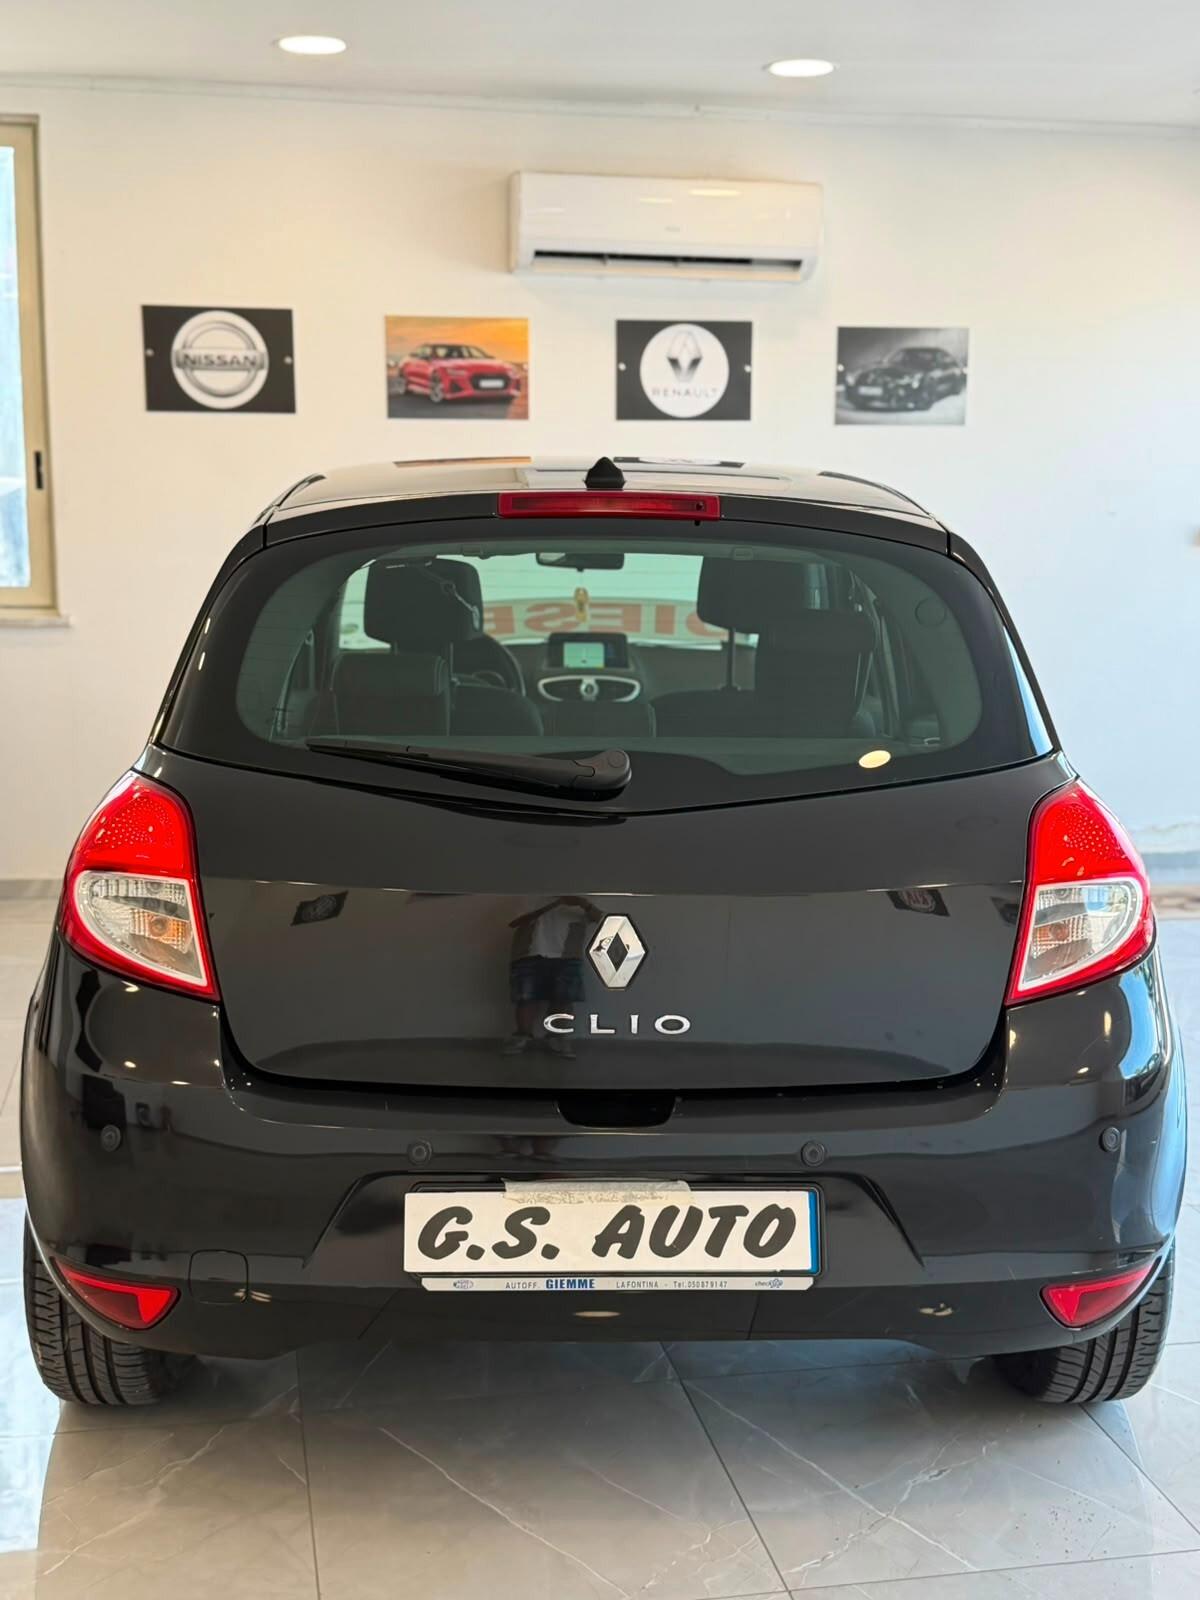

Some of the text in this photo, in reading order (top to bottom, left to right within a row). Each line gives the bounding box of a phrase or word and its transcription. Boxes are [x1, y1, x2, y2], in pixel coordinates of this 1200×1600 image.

[182, 352, 258, 367] NISSAN
[651, 387, 718, 399] RENAULT
[543, 1013, 691, 1035] CLIO
[417, 1203, 797, 1261] G.S. AUTO
[545, 1278, 596, 1289] GIEMME
